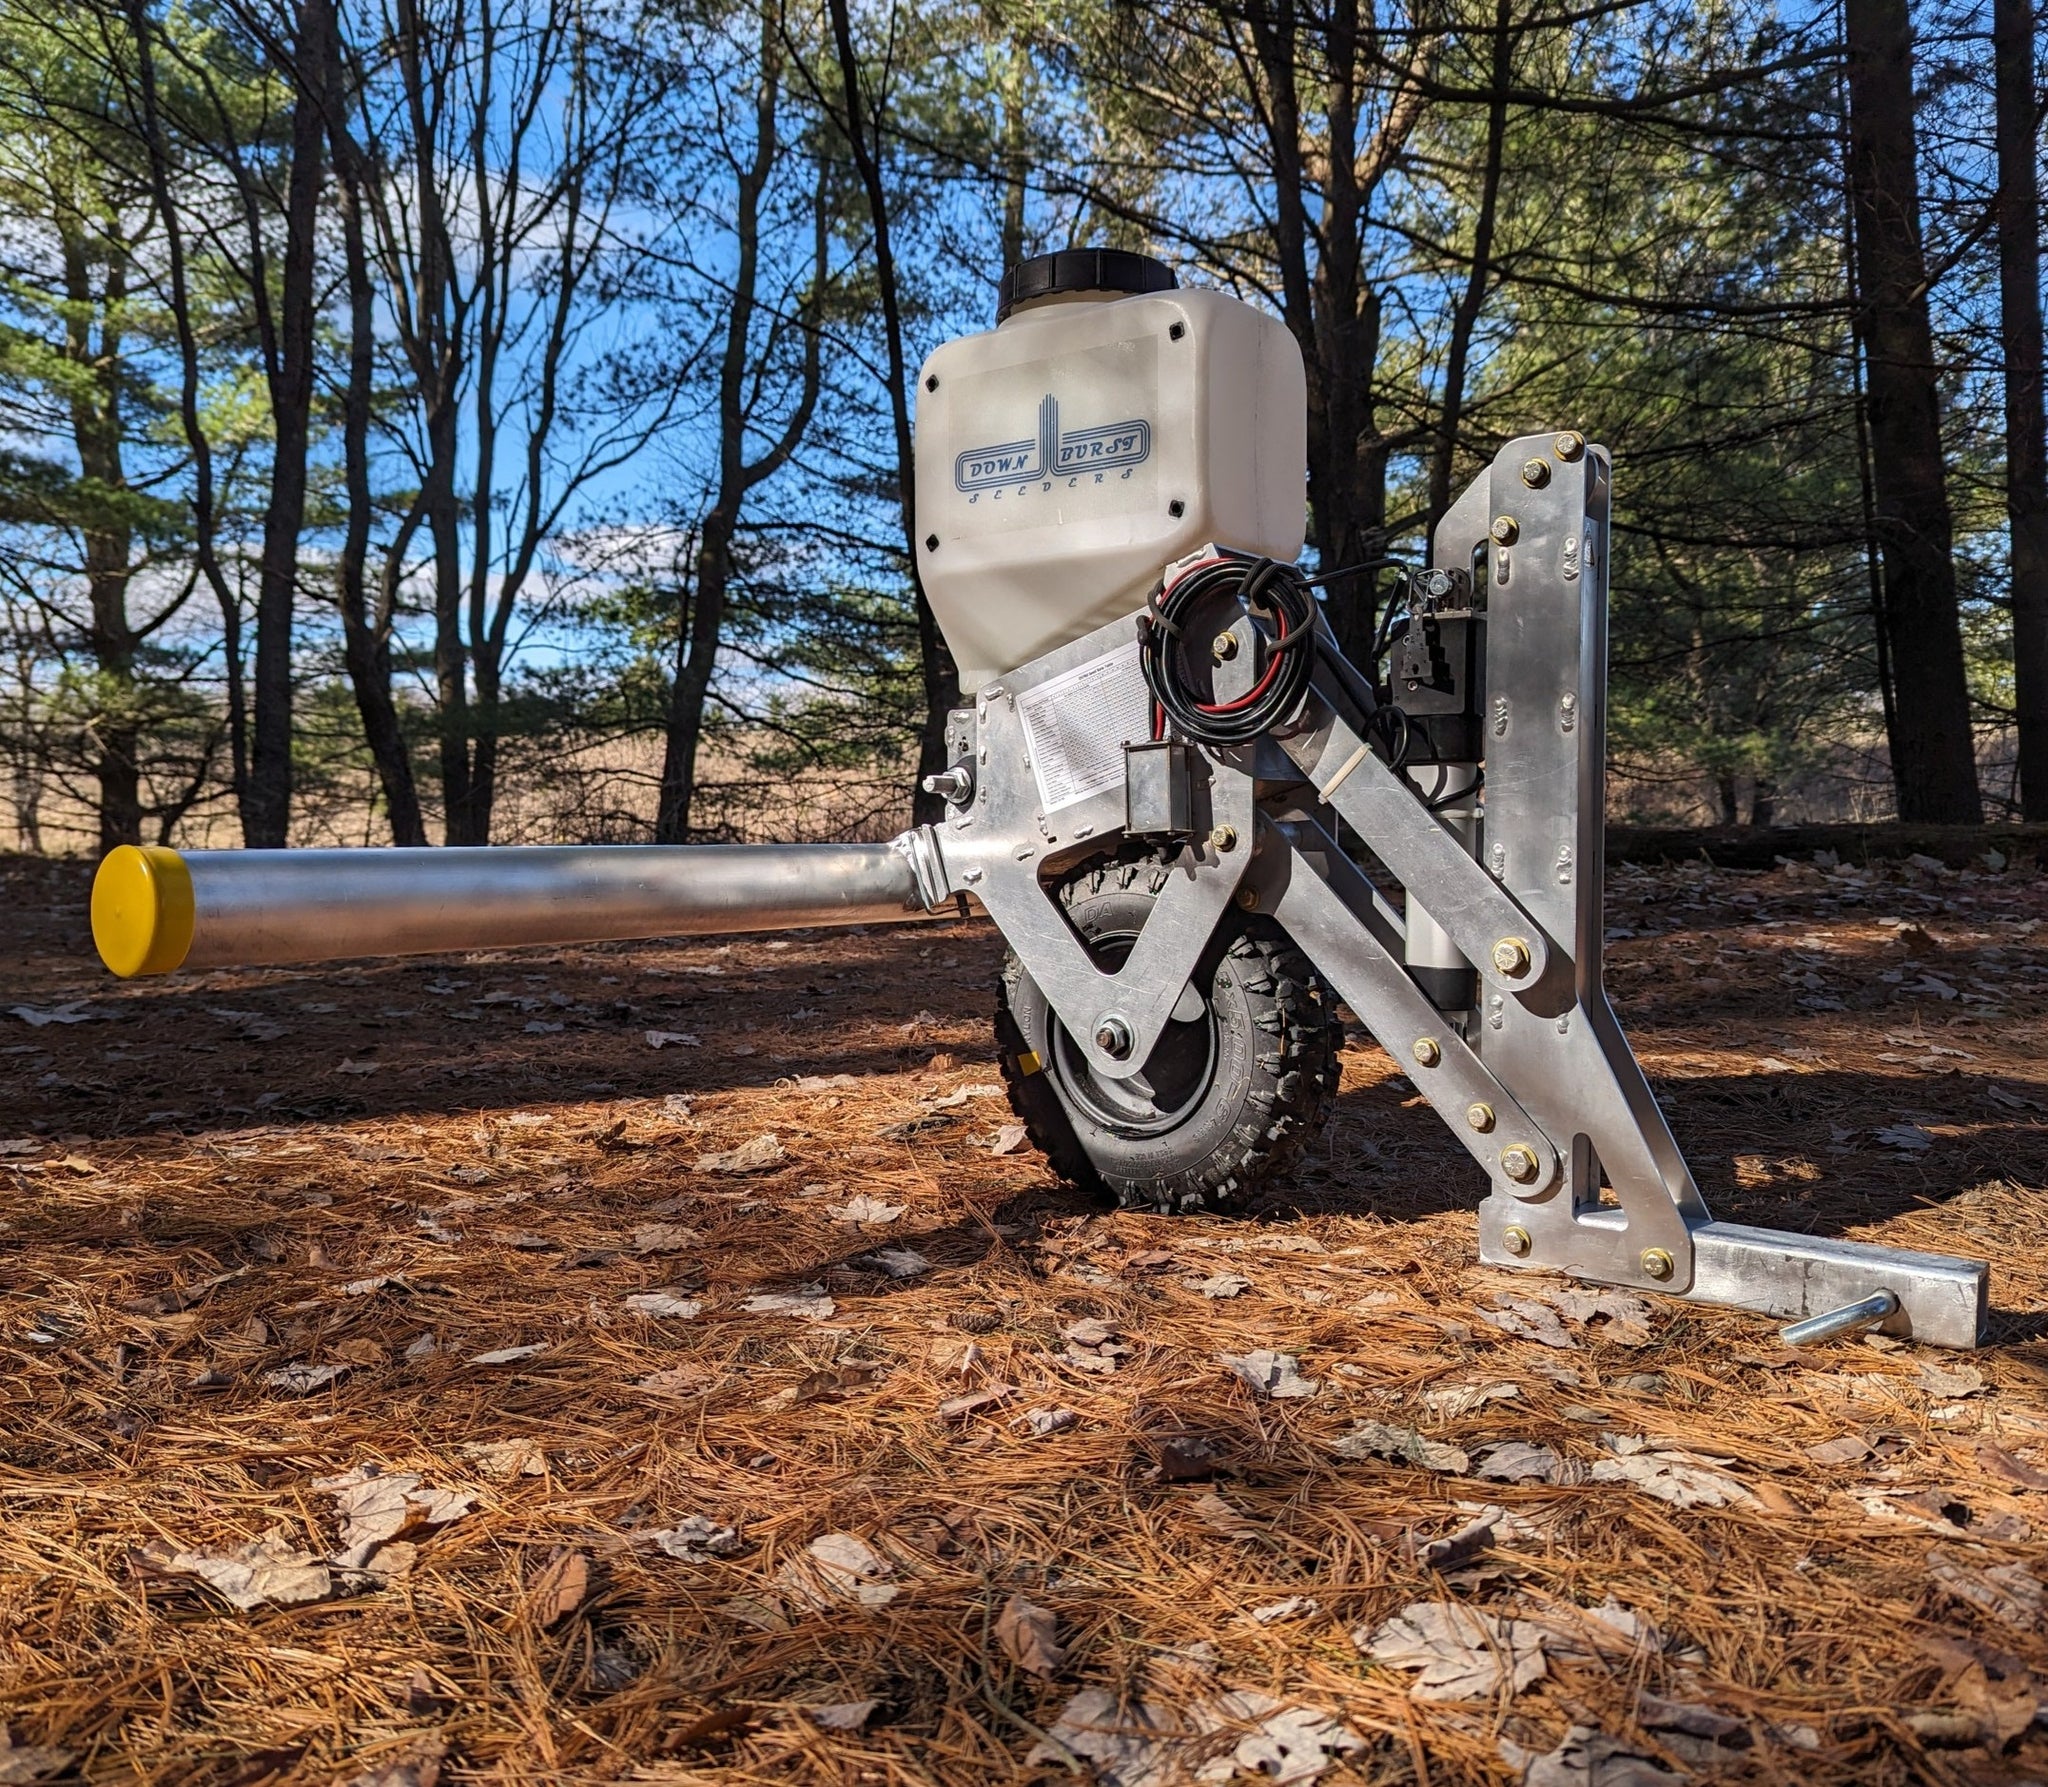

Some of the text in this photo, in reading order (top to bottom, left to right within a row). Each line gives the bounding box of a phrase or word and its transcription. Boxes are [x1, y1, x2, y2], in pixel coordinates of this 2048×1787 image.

[969, 434, 1138, 478] DOWN BURST
[968, 468, 1134, 504] SEEDERS
[1022, 1005, 1033, 1044] NYLON
